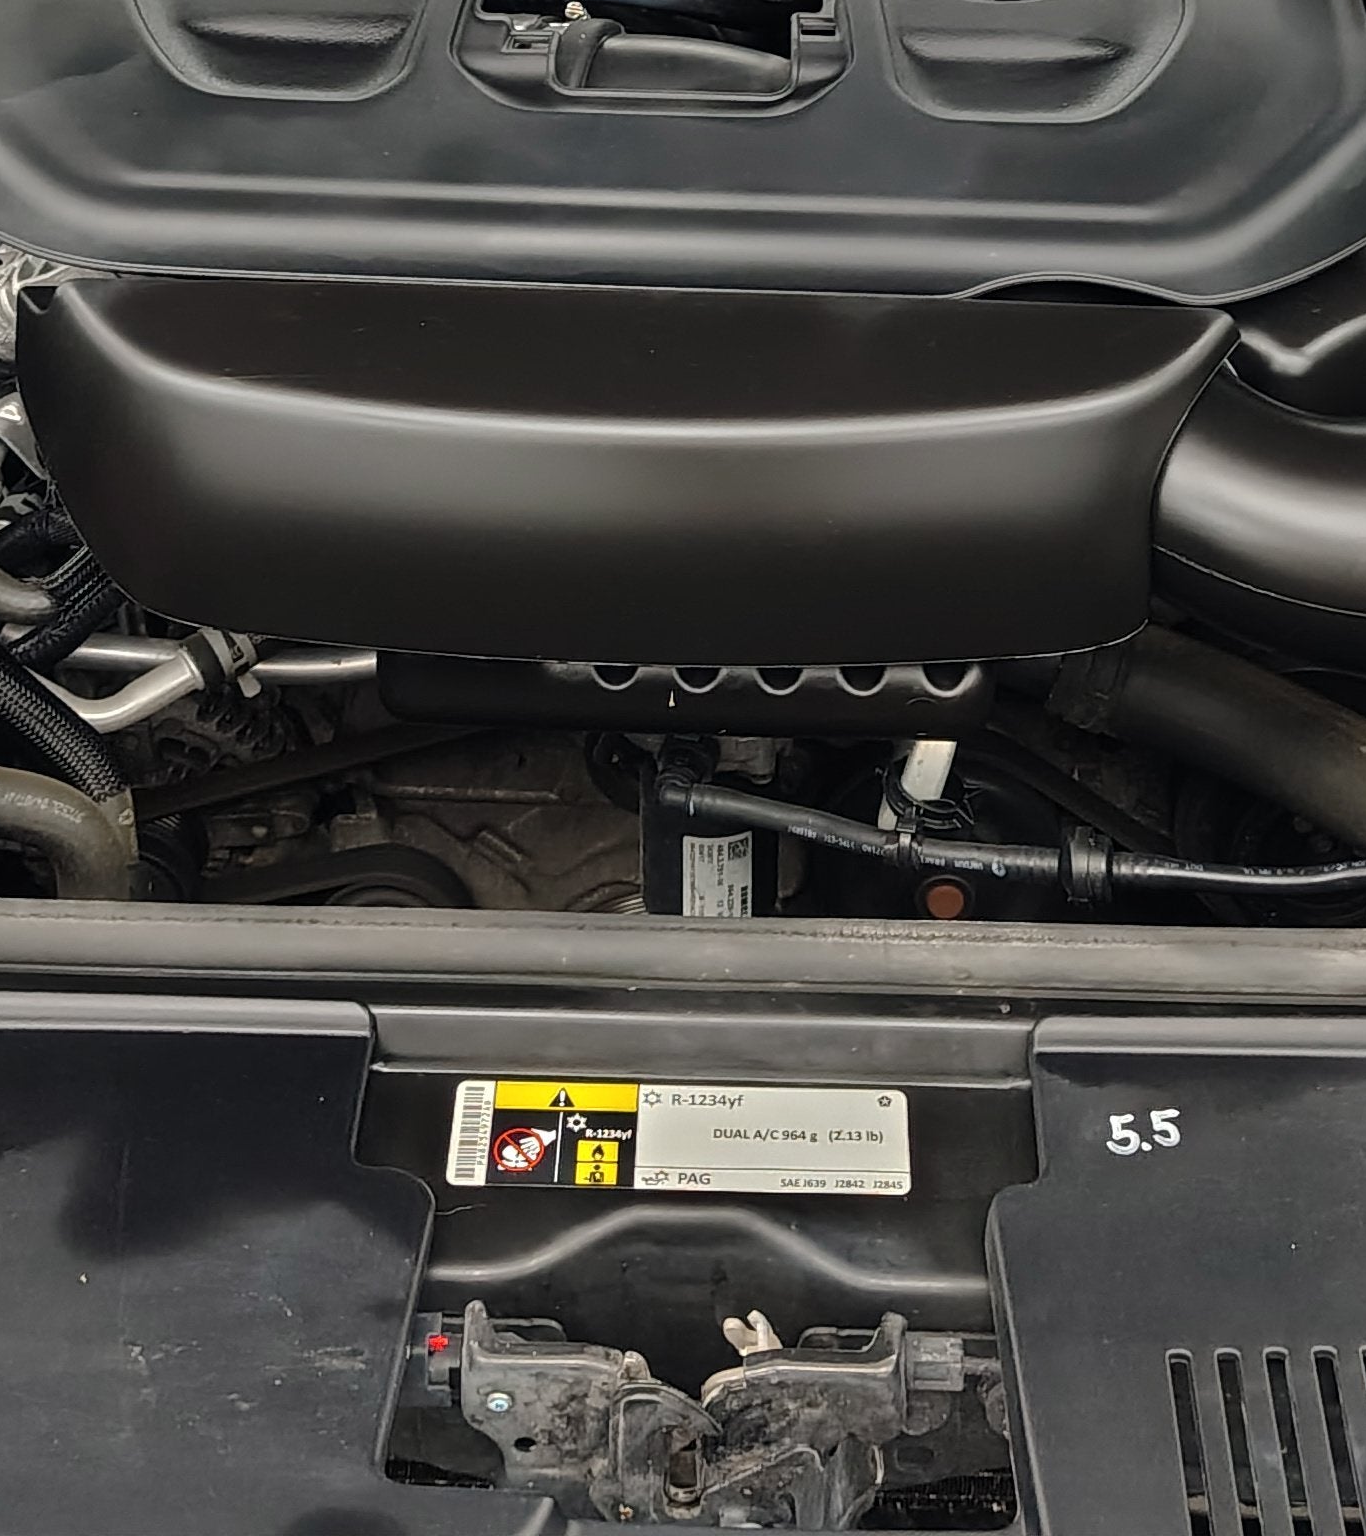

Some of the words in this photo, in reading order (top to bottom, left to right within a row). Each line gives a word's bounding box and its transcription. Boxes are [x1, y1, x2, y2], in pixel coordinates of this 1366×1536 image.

[671, 1093, 744, 1110] R-1234yf
[585, 1128, 633, 1141] R-1234yf
[713, 1128, 750, 1141] DUAL
[751, 1128, 780, 1142] A/C
[781, 1130, 807, 1142] 964
[809, 1132, 818, 1144] g
[828, 1130, 863, 1145] (2.13
[866, 1130, 885, 1145] lb)
[1106, 1108, 1181, 1156] 5.5
[677, 1172, 712, 1186] PAG
[780, 1178, 801, 1188] SAE
[802, 1178, 827, 1188] J639
[834, 1179, 866, 1189] J2842
[872, 1179, 904, 1190] J2845
